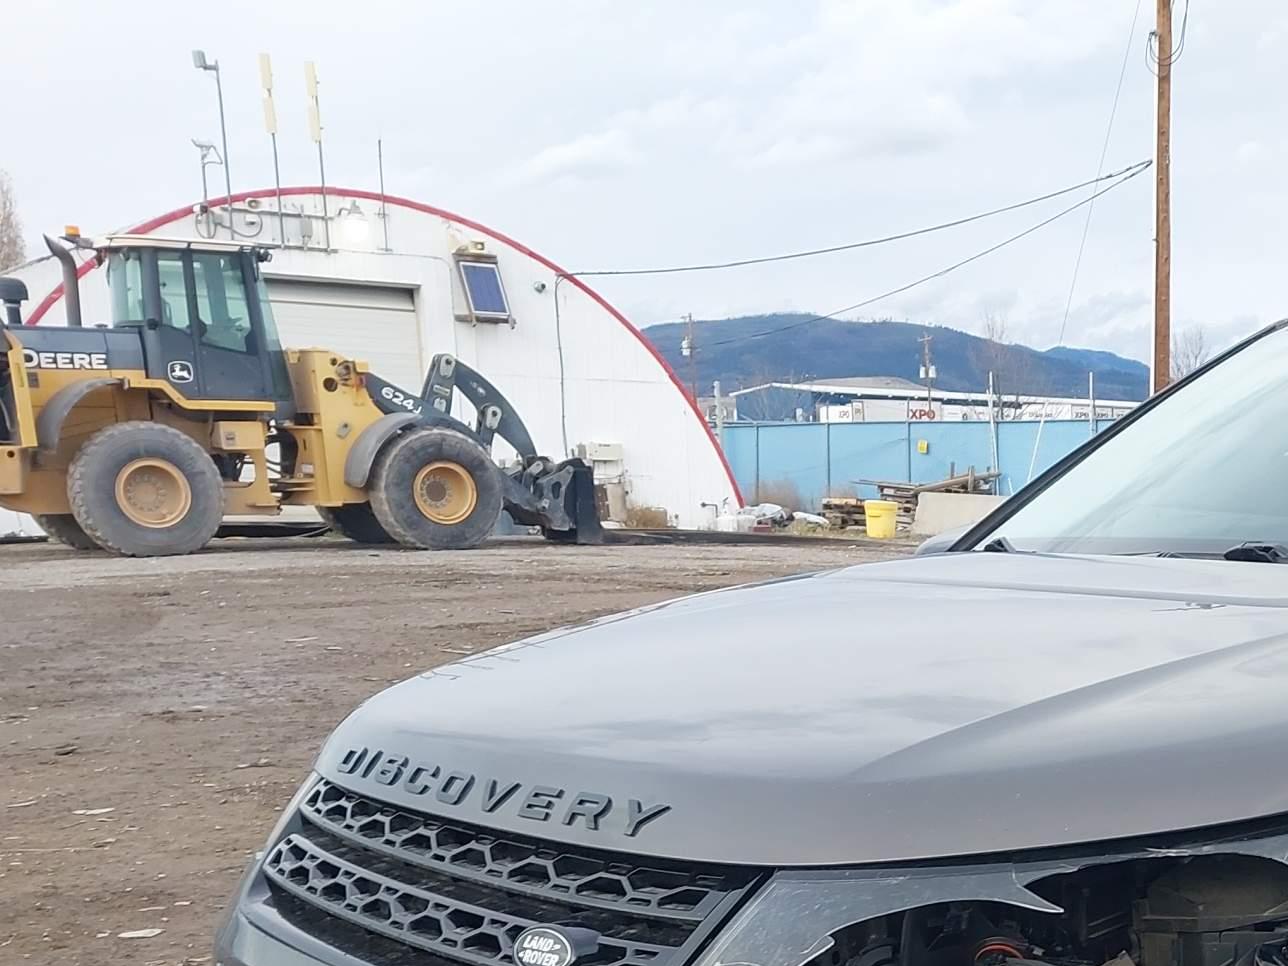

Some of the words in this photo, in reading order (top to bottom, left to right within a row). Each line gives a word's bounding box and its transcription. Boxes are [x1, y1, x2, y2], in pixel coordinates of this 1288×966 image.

[22, 348, 108, 369] DEERE
[909, 408, 936, 420] XPO
[336, 747, 672, 838] DISCOVERY
